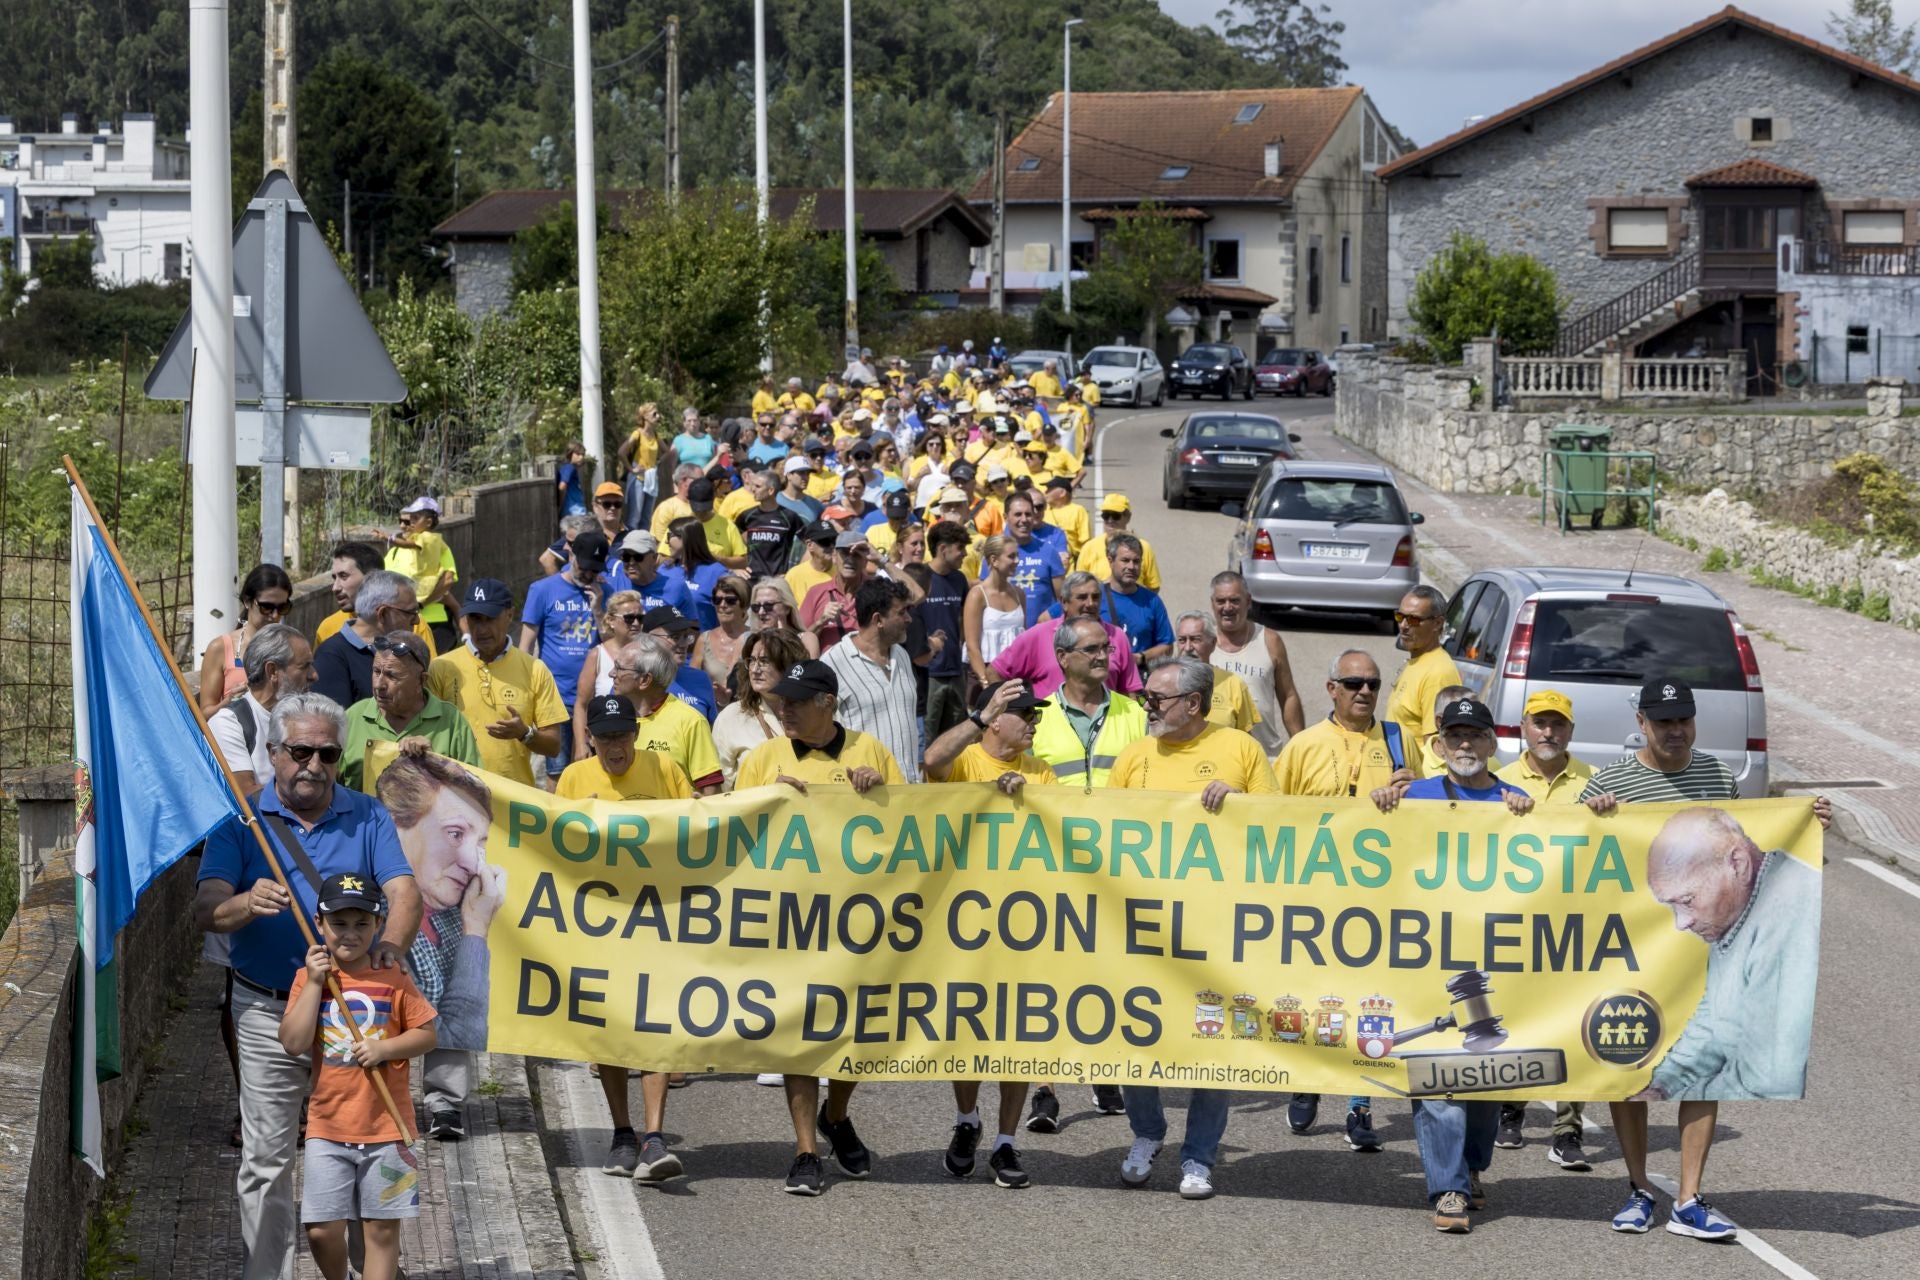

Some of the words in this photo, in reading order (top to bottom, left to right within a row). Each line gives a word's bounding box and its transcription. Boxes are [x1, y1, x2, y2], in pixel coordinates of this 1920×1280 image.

[554, 600, 566, 611] On
[566, 600, 581, 612] The
[509, 801, 652, 869] POR
[677, 811, 821, 874] UNA
[842, 812, 1223, 883] CANTABRIA
[1246, 812, 1391, 888] MÁS
[1416, 832, 1633, 895] JUSTA
[518, 872, 924, 955] ACABEMOS
[948, 890, 1096, 952] CON
[1126, 898, 1207, 961] EL
[1233, 904, 1640, 973] PROBLEMA
[517, 958, 609, 1029] DE
[634, 973, 776, 1042] LOS
[802, 981, 1162, 1046] DERRIBOS
[1600, 1002, 1647, 1018] AMA
[838, 1055, 938, 1076] Asociación
[943, 1056, 967, 1074] de
[973, 1055, 1084, 1077] Maltratados
[1090, 1061, 1121, 1081] por
[1126, 1059, 1143, 1079] la
[1149, 1060, 1290, 1085] Administración
[1352, 1060, 1396, 1069] GOBIERNO
[1422, 1057, 1546, 1090] Justicia
